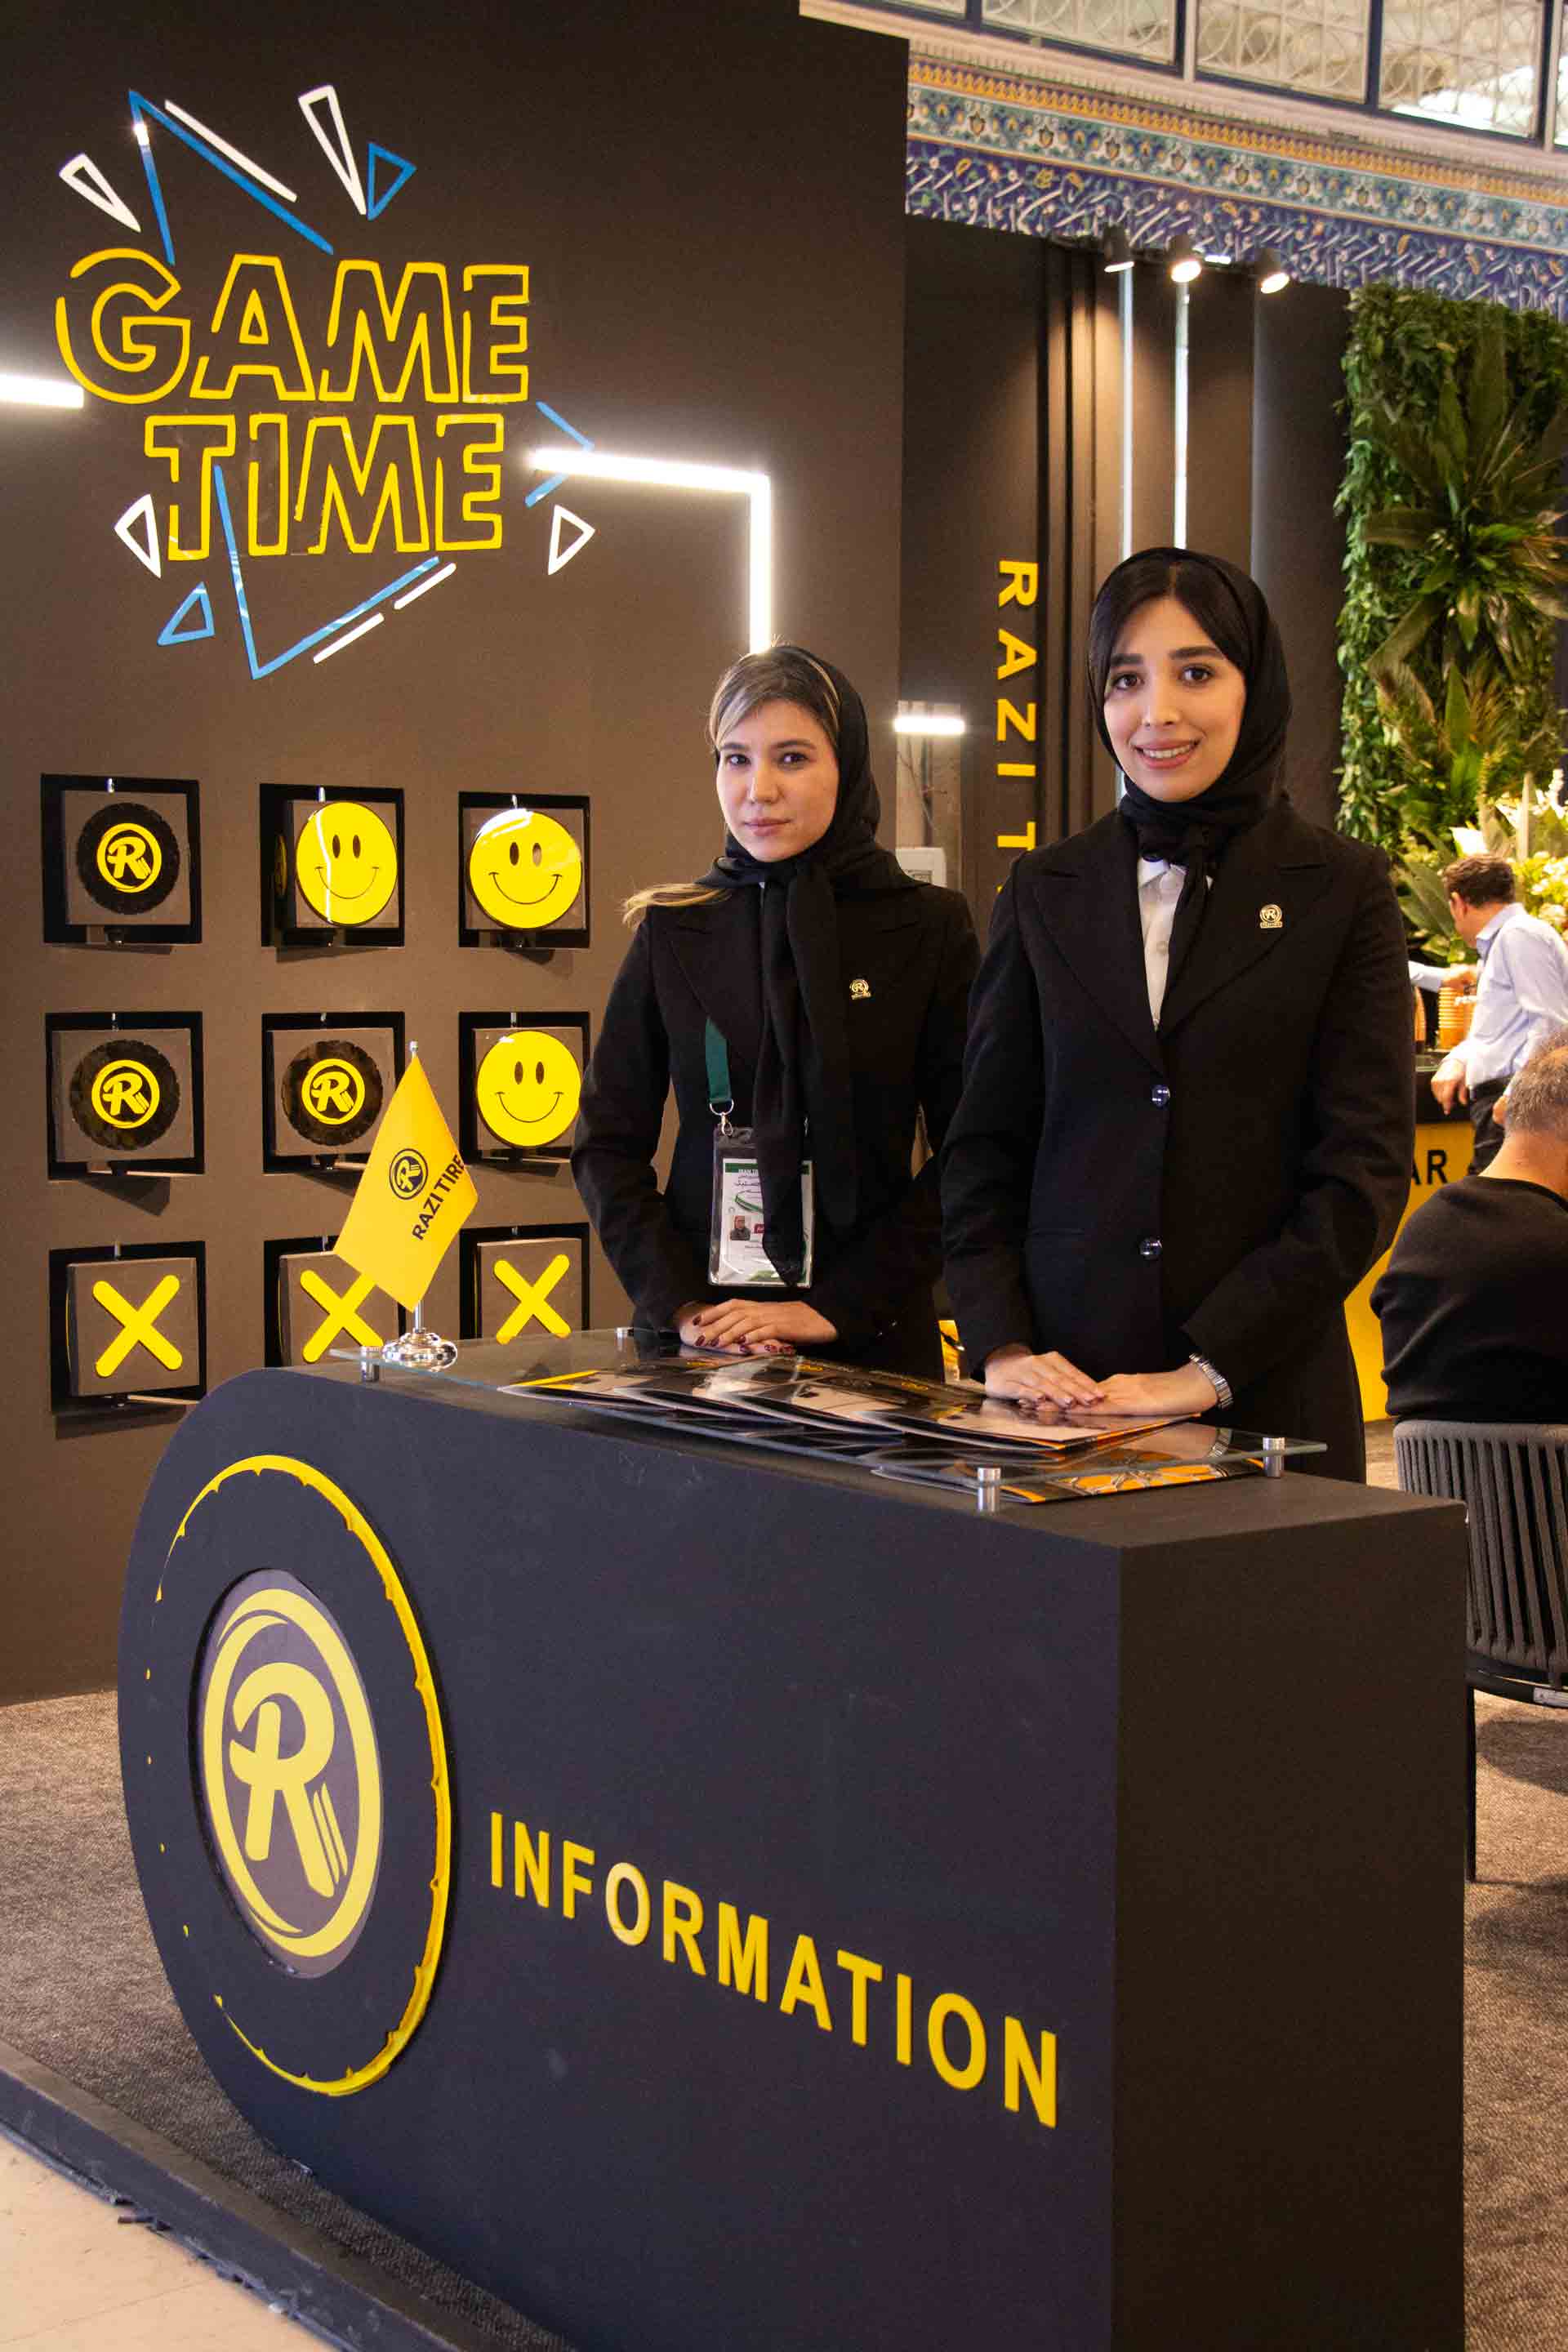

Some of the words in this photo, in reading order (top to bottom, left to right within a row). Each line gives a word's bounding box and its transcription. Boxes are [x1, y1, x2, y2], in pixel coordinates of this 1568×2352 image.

[56, 248, 529, 404] GAME
[144, 412, 505, 561] TIME
[997, 560, 1038, 776] RAZI
[412, 1192, 444, 1241] RAZI
[434, 1154, 465, 1192] TIRE
[491, 1811, 1056, 2128] INFORMATION
